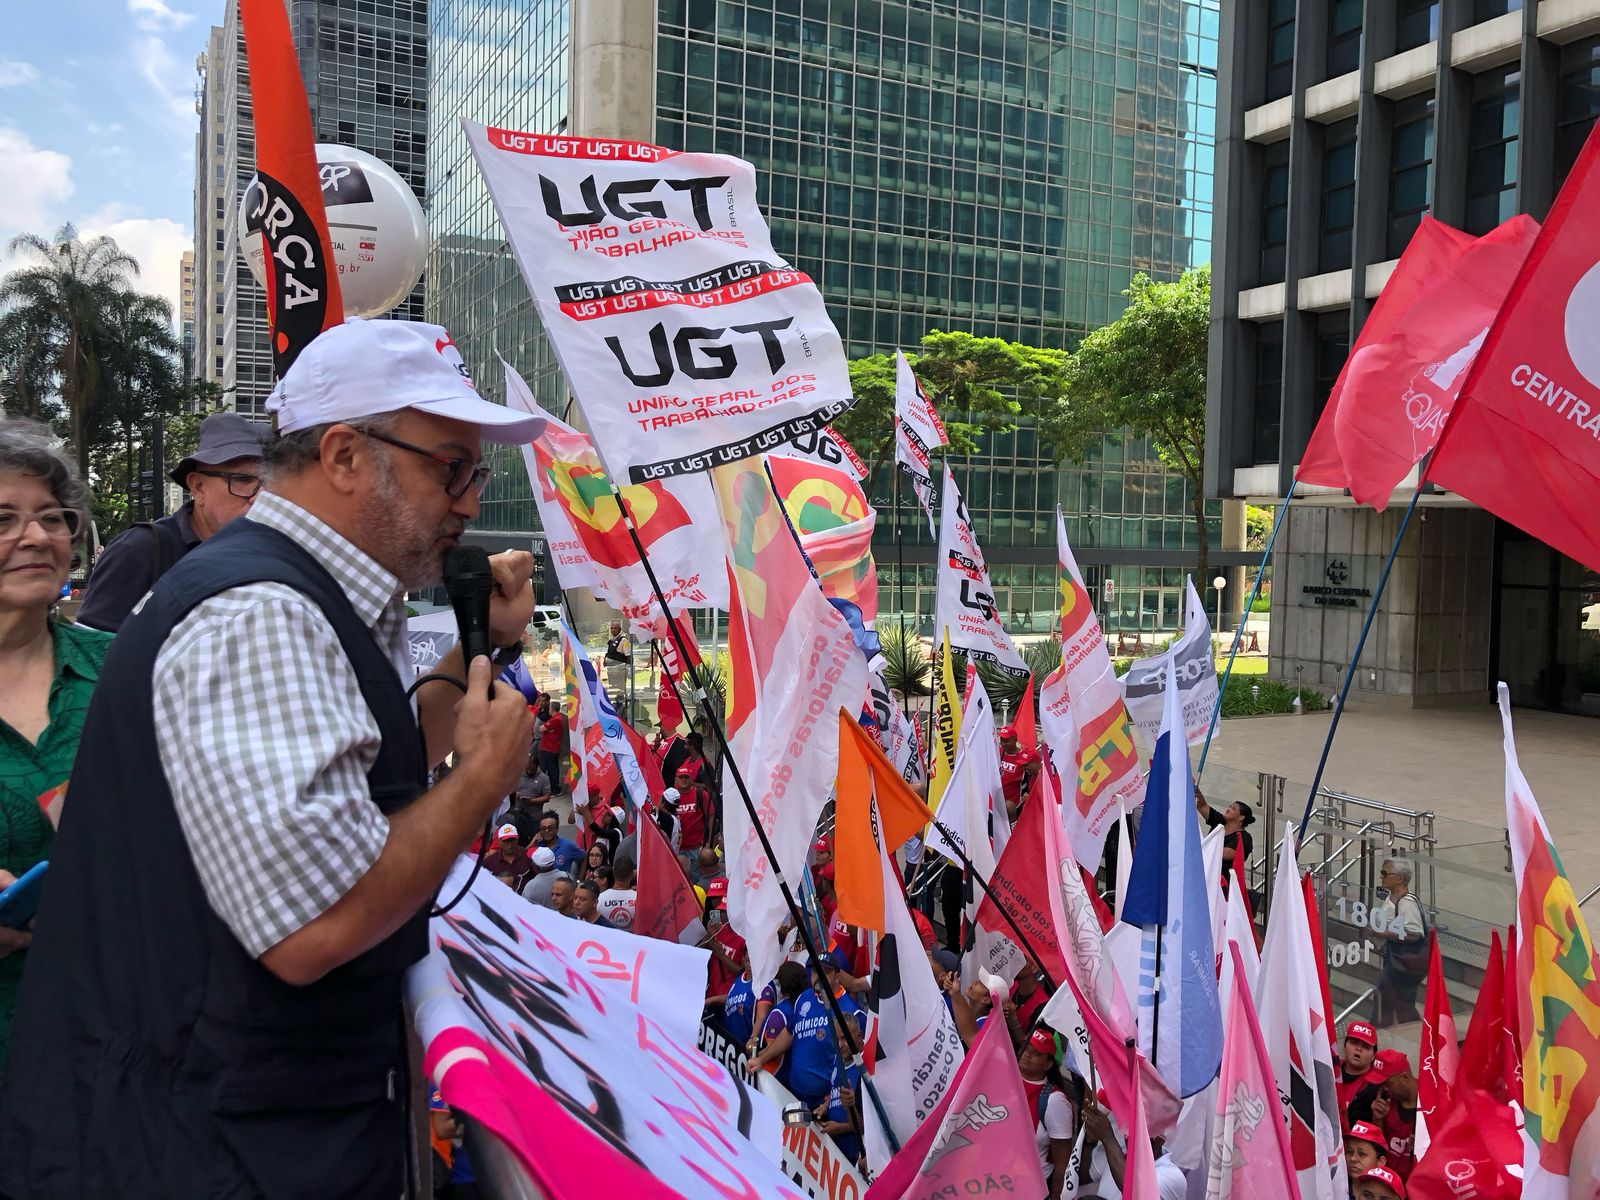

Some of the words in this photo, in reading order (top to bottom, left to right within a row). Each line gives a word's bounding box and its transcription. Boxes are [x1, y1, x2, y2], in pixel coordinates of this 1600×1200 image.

[501, 133, 538, 149] UGT
[544, 138, 581, 156] UGT
[586, 142, 623, 158] UGT
[628, 143, 660, 161] UGT
[538, 173, 731, 232] UGT
[728, 186, 737, 229] BRASIL
[569, 284, 607, 301] UGT
[611, 279, 645, 295] UGT
[651, 281, 683, 294] UGT
[688, 271, 723, 292] UGT
[727, 262, 761, 281] UGT
[572, 299, 608, 318] UGT
[613, 293, 647, 311] UGT
[655, 289, 686, 305] UGT
[690, 289, 724, 307] UGT
[729, 278, 764, 298] UGT
[768, 270, 802, 287] UGT
[604, 316, 795, 388] UGT
[770, 373, 817, 393] DOS
[641, 463, 676, 480] UGT
[681, 454, 714, 472] UGT
[718, 441, 752, 461] UGT
[756, 427, 790, 450] UGT
[790, 416, 824, 436] UGT
[1303, 586, 1332, 595] BANCO
[1333, 587, 1372, 597] CENTRAL
[1328, 597, 1358, 608] BRASIL
[1335, 896, 1407, 941] 1804
